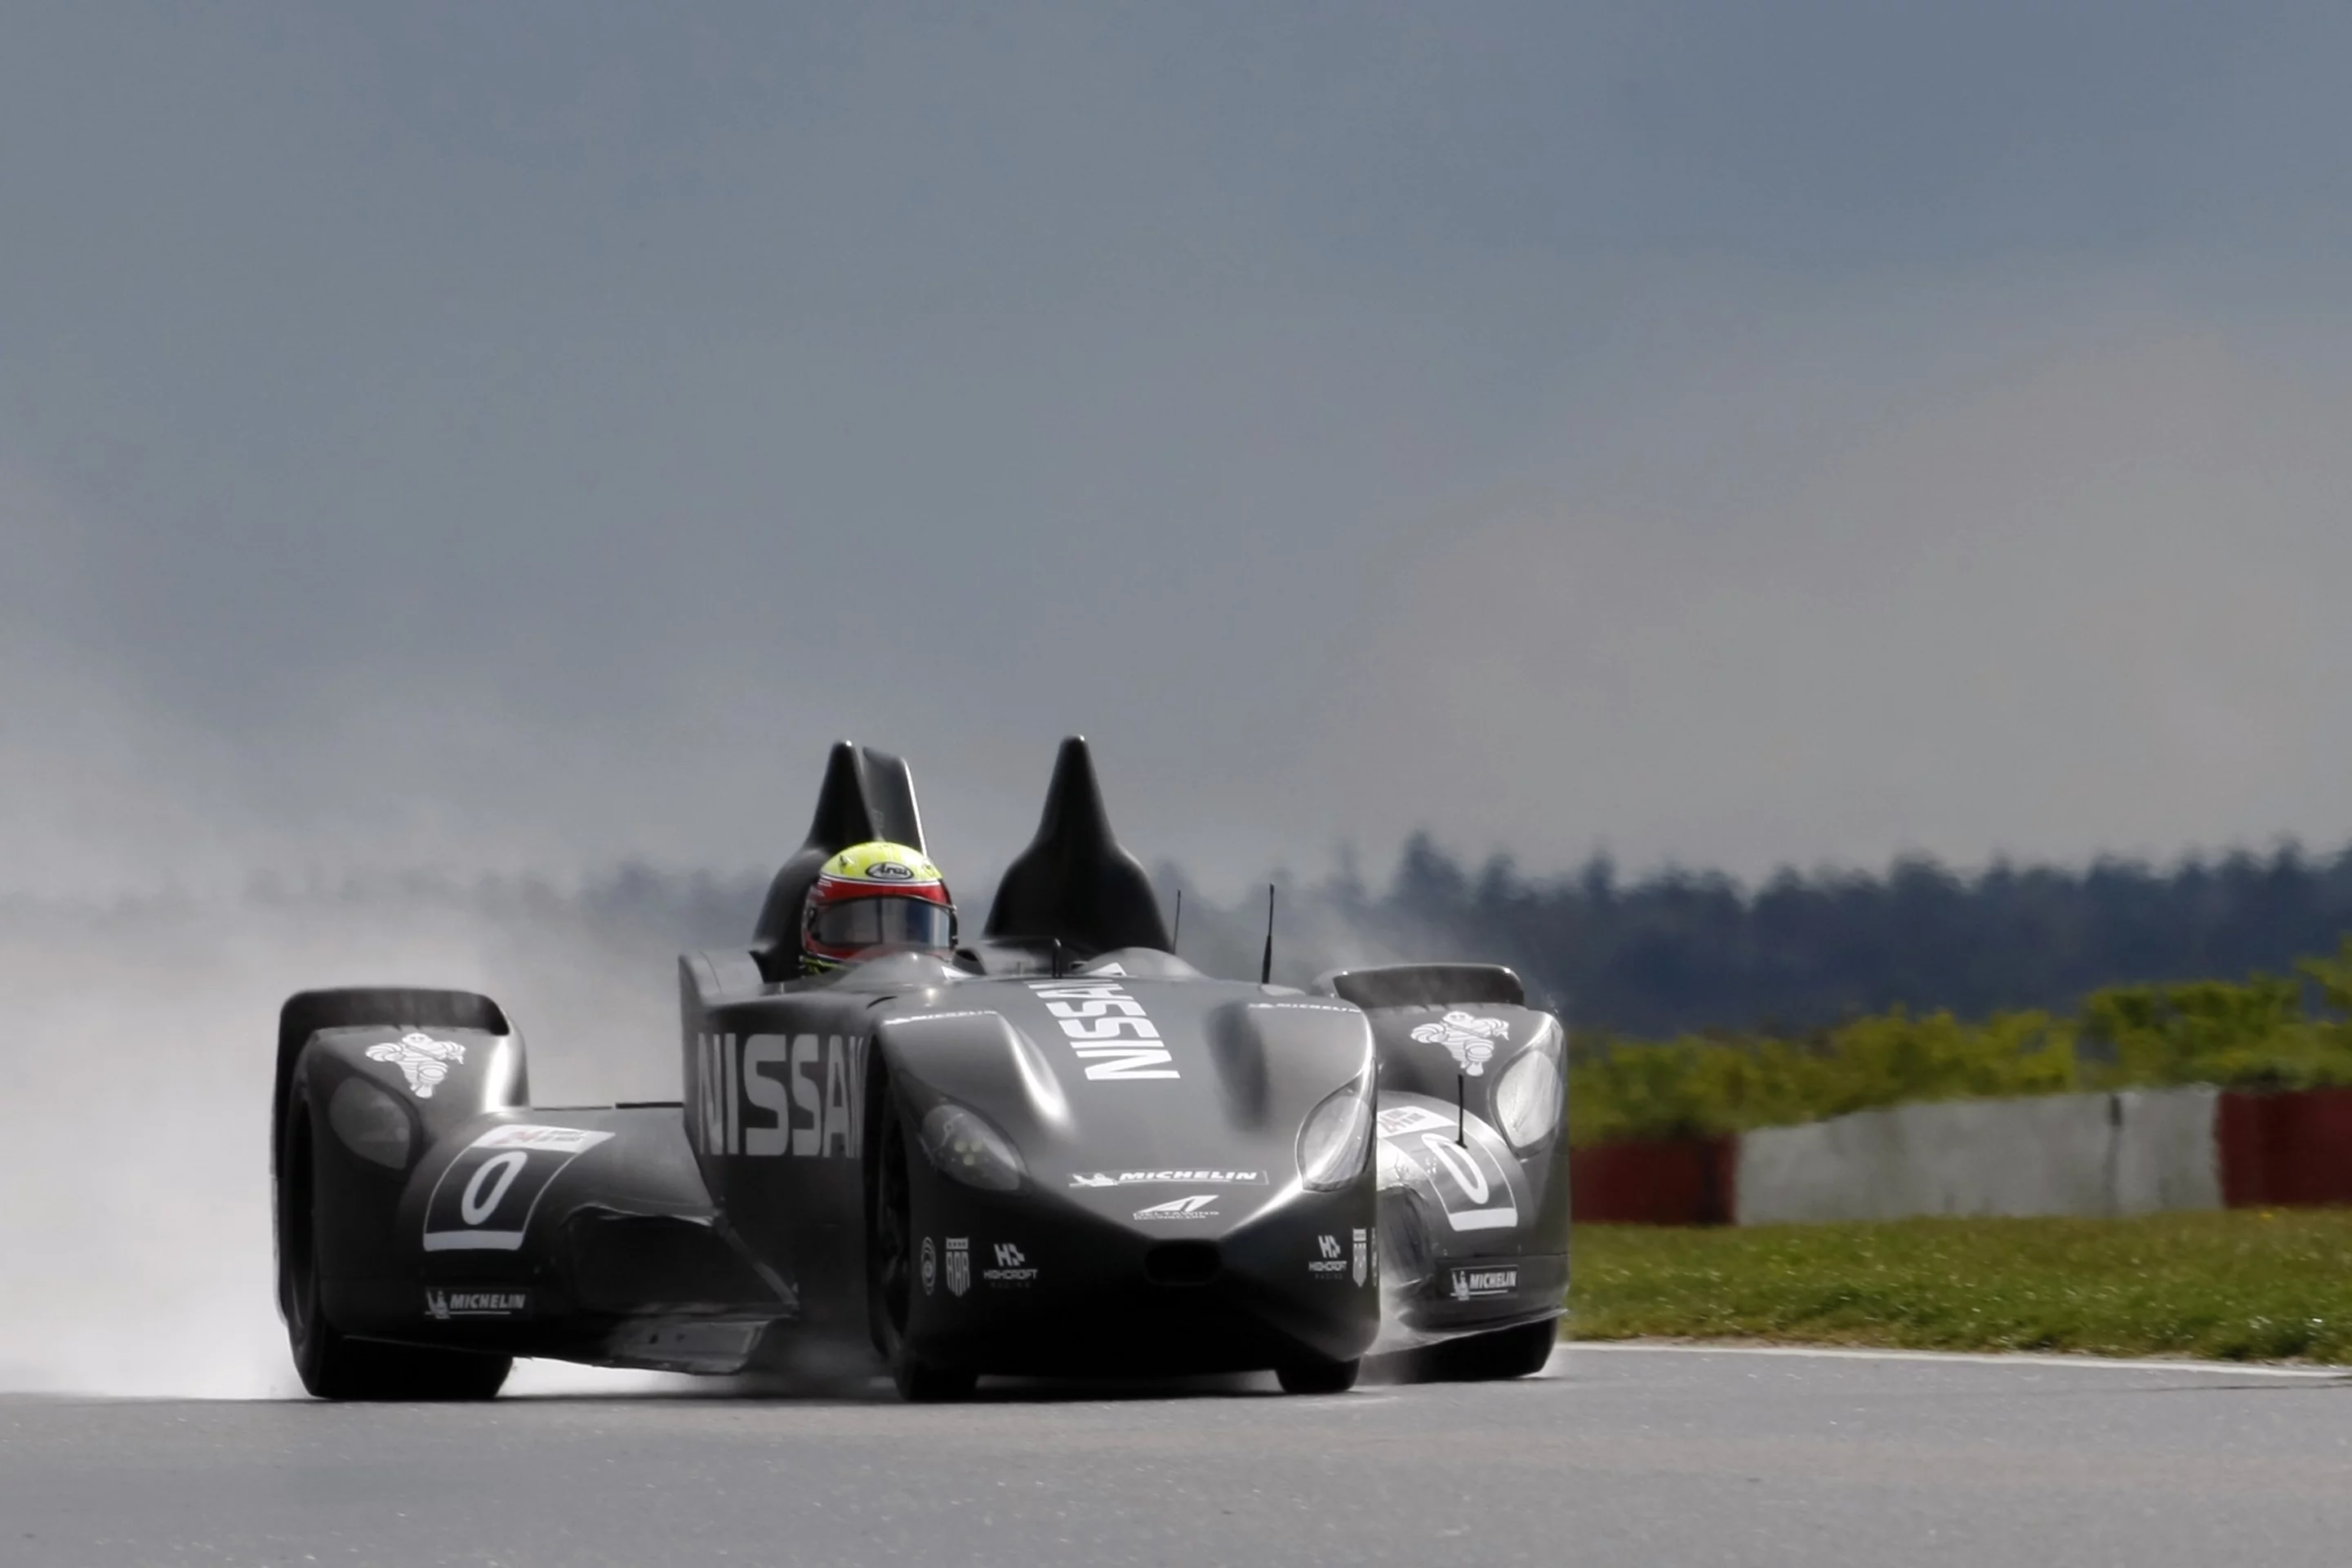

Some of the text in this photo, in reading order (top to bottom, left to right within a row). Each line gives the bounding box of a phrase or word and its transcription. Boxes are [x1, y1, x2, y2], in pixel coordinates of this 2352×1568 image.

[870, 862, 908, 875] Arai
[1022, 979, 1181, 1080] NISSAN
[1119, 1170, 1258, 1181] MICHELIN
[1421, 1133, 1490, 1205] 0
[461, 1151, 528, 1225] 0
[1469, 1271, 1517, 1290] MICHELIN
[450, 1294, 526, 1309] MICHELIN
